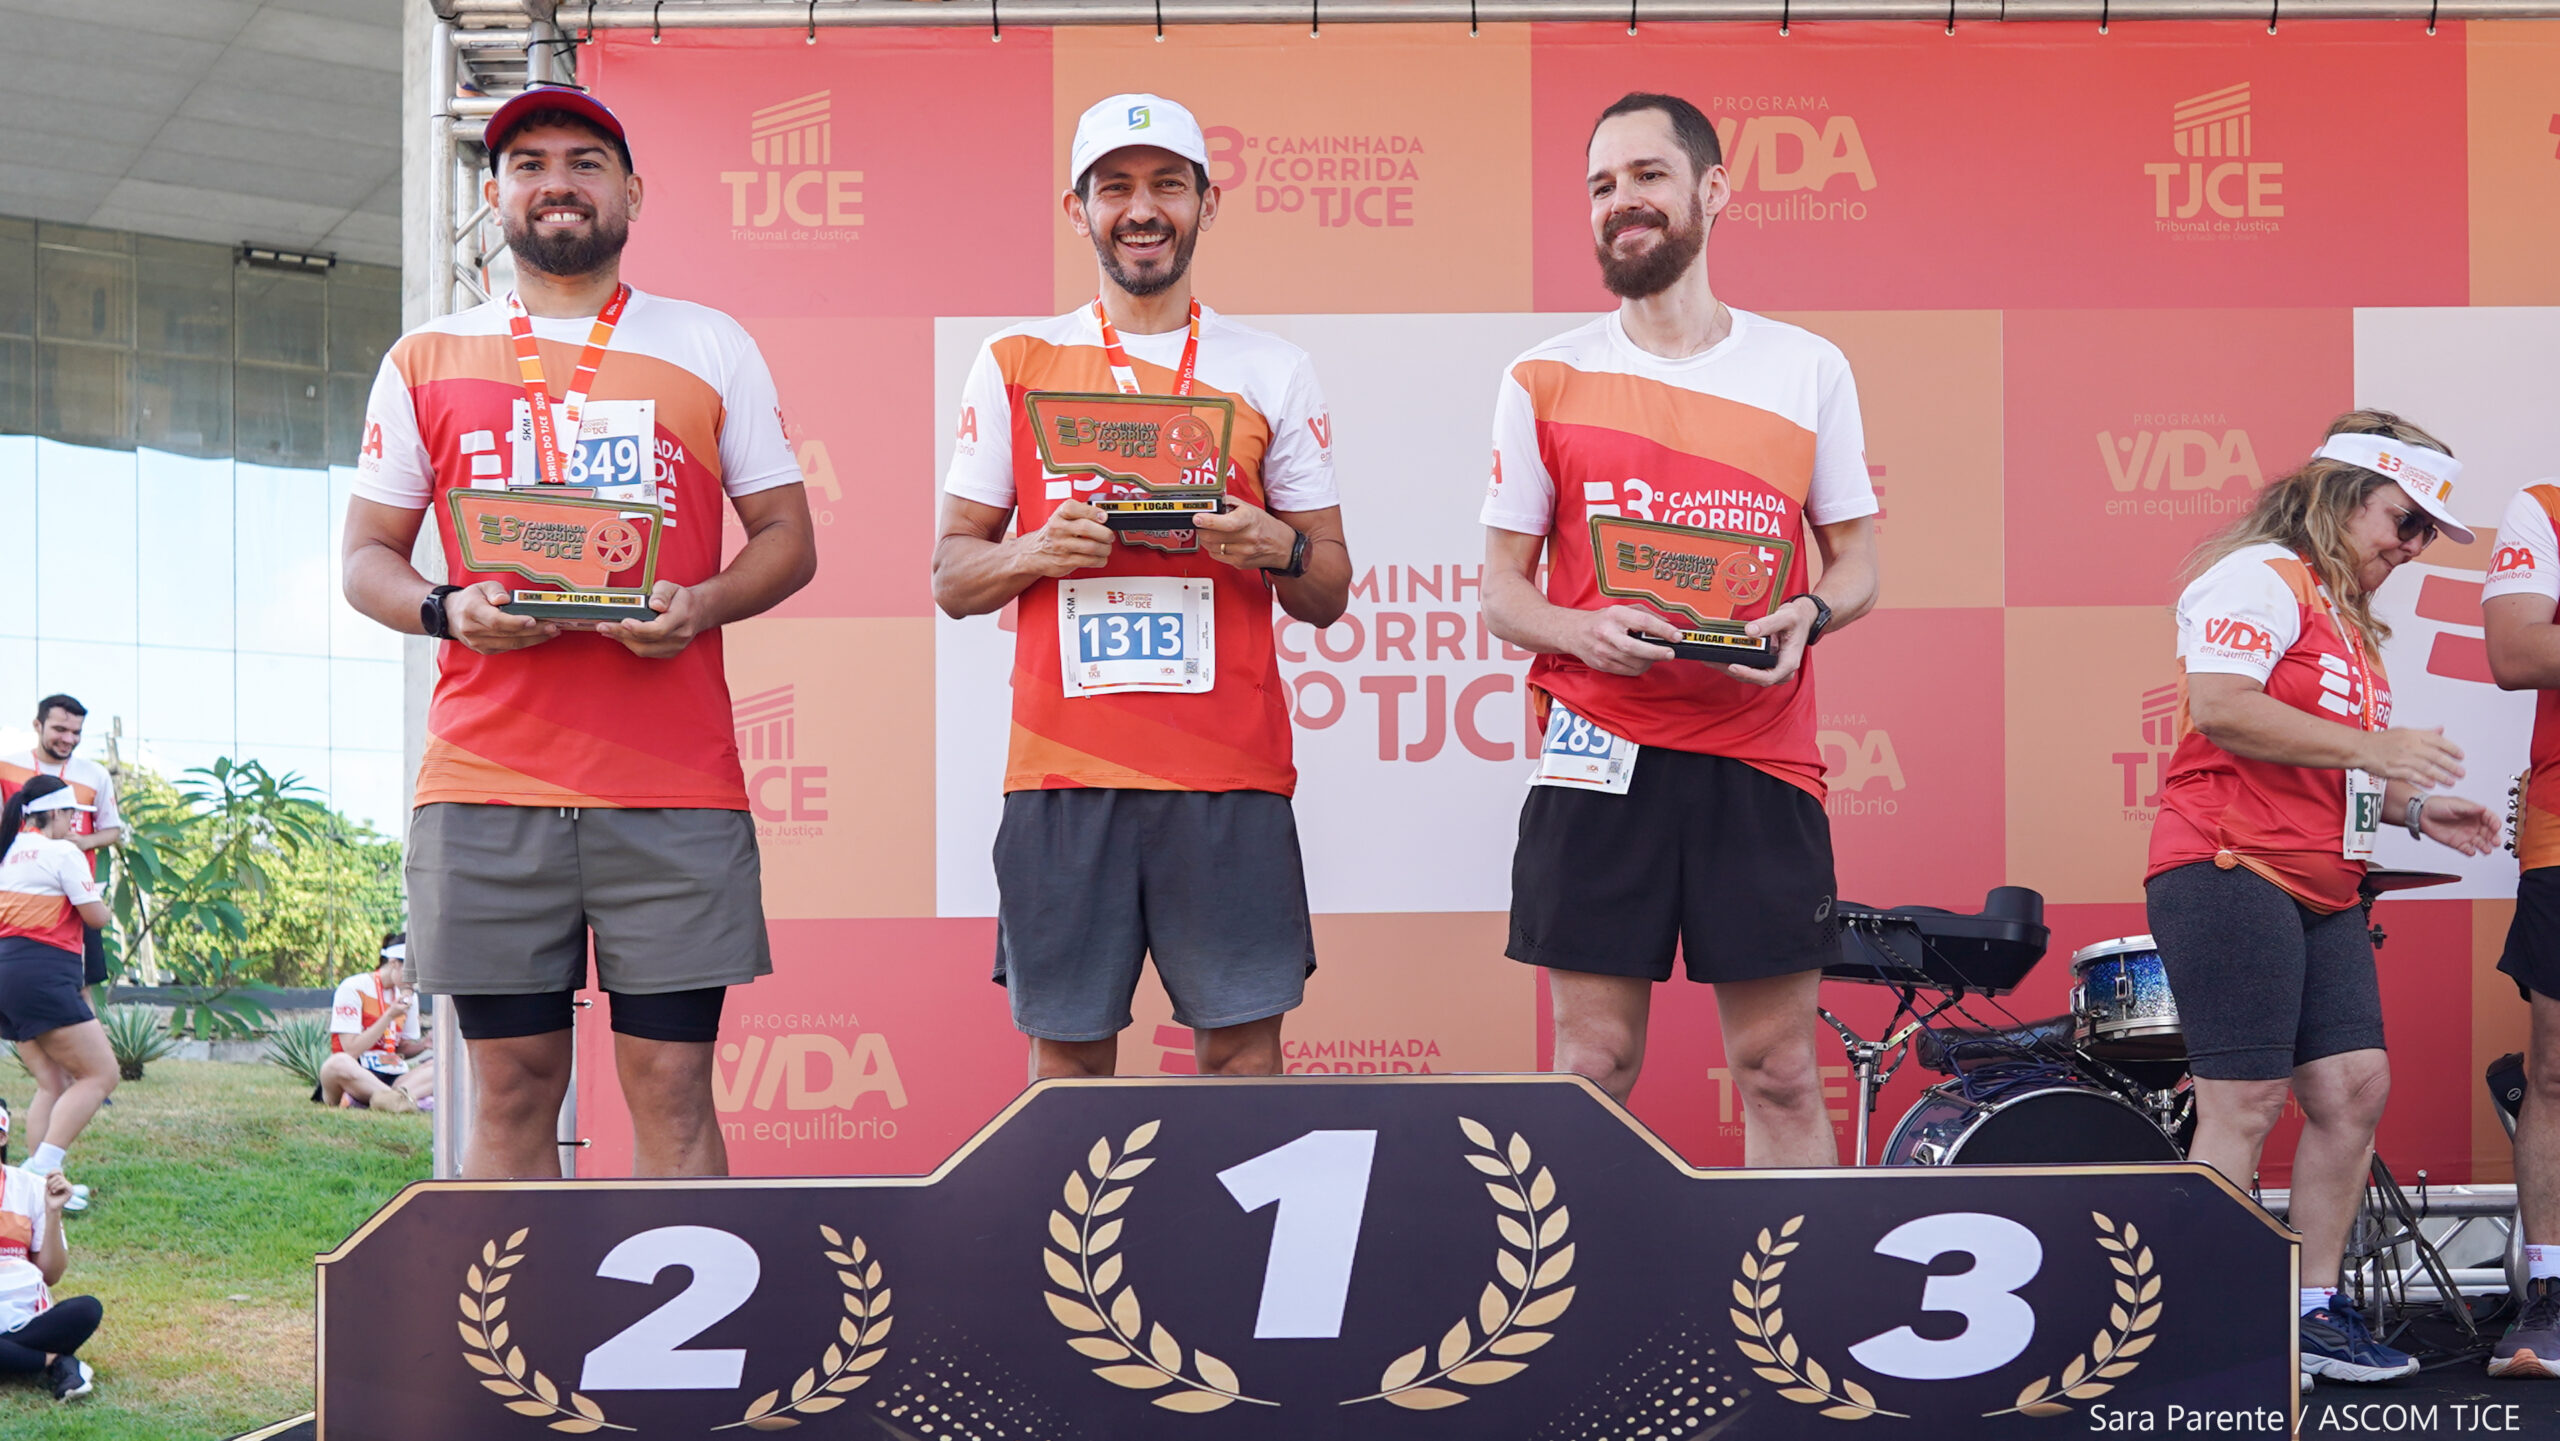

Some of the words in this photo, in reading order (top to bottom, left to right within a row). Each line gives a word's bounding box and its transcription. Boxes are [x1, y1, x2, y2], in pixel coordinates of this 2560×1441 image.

[1713, 96, 1830, 111] PROGRAMA
[1266, 136, 1425, 155] CAMINHADA
[720, 169, 865, 227] TJCE
[2143, 162, 2285, 219] TJCE
[1256, 184, 1305, 213] DO
[1310, 186, 1414, 228] TJCE
[1725, 193, 1868, 230] equilíbrio
[730, 229, 788, 241] Tribunal
[791, 229, 809, 241] de
[812, 229, 860, 243] Justiça
[2154, 220, 2210, 232] Tribunal
[2213, 220, 2231, 232] de
[2234, 220, 2280, 234] Justiça
[522, 418, 531, 441] 5KM
[540, 415, 549, 434] TJCE
[1101, 421, 1160, 432] CAMINHADA
[2133, 413, 2228, 426] PROGRAMA
[1117, 440, 1158, 458] TJCE
[546, 450, 559, 483] ORRIDA
[571, 439, 640, 484] 849
[1143, 502, 1175, 511] LUGAR
[1669, 490, 1787, 515] CAMINHADA
[2104, 499, 2138, 516] em
[525, 521, 587, 534] CAMINHADA
[543, 542, 584, 560] TJCE
[1660, 550, 1719, 567] CAMINHADA
[1673, 571, 1713, 592] TJCE
[569, 594, 603, 604] LUGAR
[1066, 596, 1076, 620] 5KM
[1082, 615, 1182, 658] 1313
[1274, 611, 1537, 663] CORRI
[1693, 632, 1725, 644] LUGAR
[1821, 713, 1869, 727] RAMA
[1549, 709, 1613, 755] 285
[1815, 730, 1907, 793] DA
[2112, 752, 2171, 808] TJ
[748, 765, 828, 823] CE
[1826, 792, 1899, 816] ilíbrio
[2122, 810, 2156, 822] Tribu
[756, 825, 773, 837] de
[777, 824, 824, 839] Justiça
[741, 1014, 860, 1029] PROGRAMA
[1282, 1040, 1441, 1059] CAMINHADA
[1707, 1066, 1849, 1123] TE
[721, 1121, 746, 1141] m
[753, 1113, 898, 1149] equilíbrio
[1718, 1125, 1745, 1137] Trib
[1215, 1130, 1378, 1338] 1
[1846, 1212, 2043, 1380] 3
[579, 1224, 762, 1390] 2
